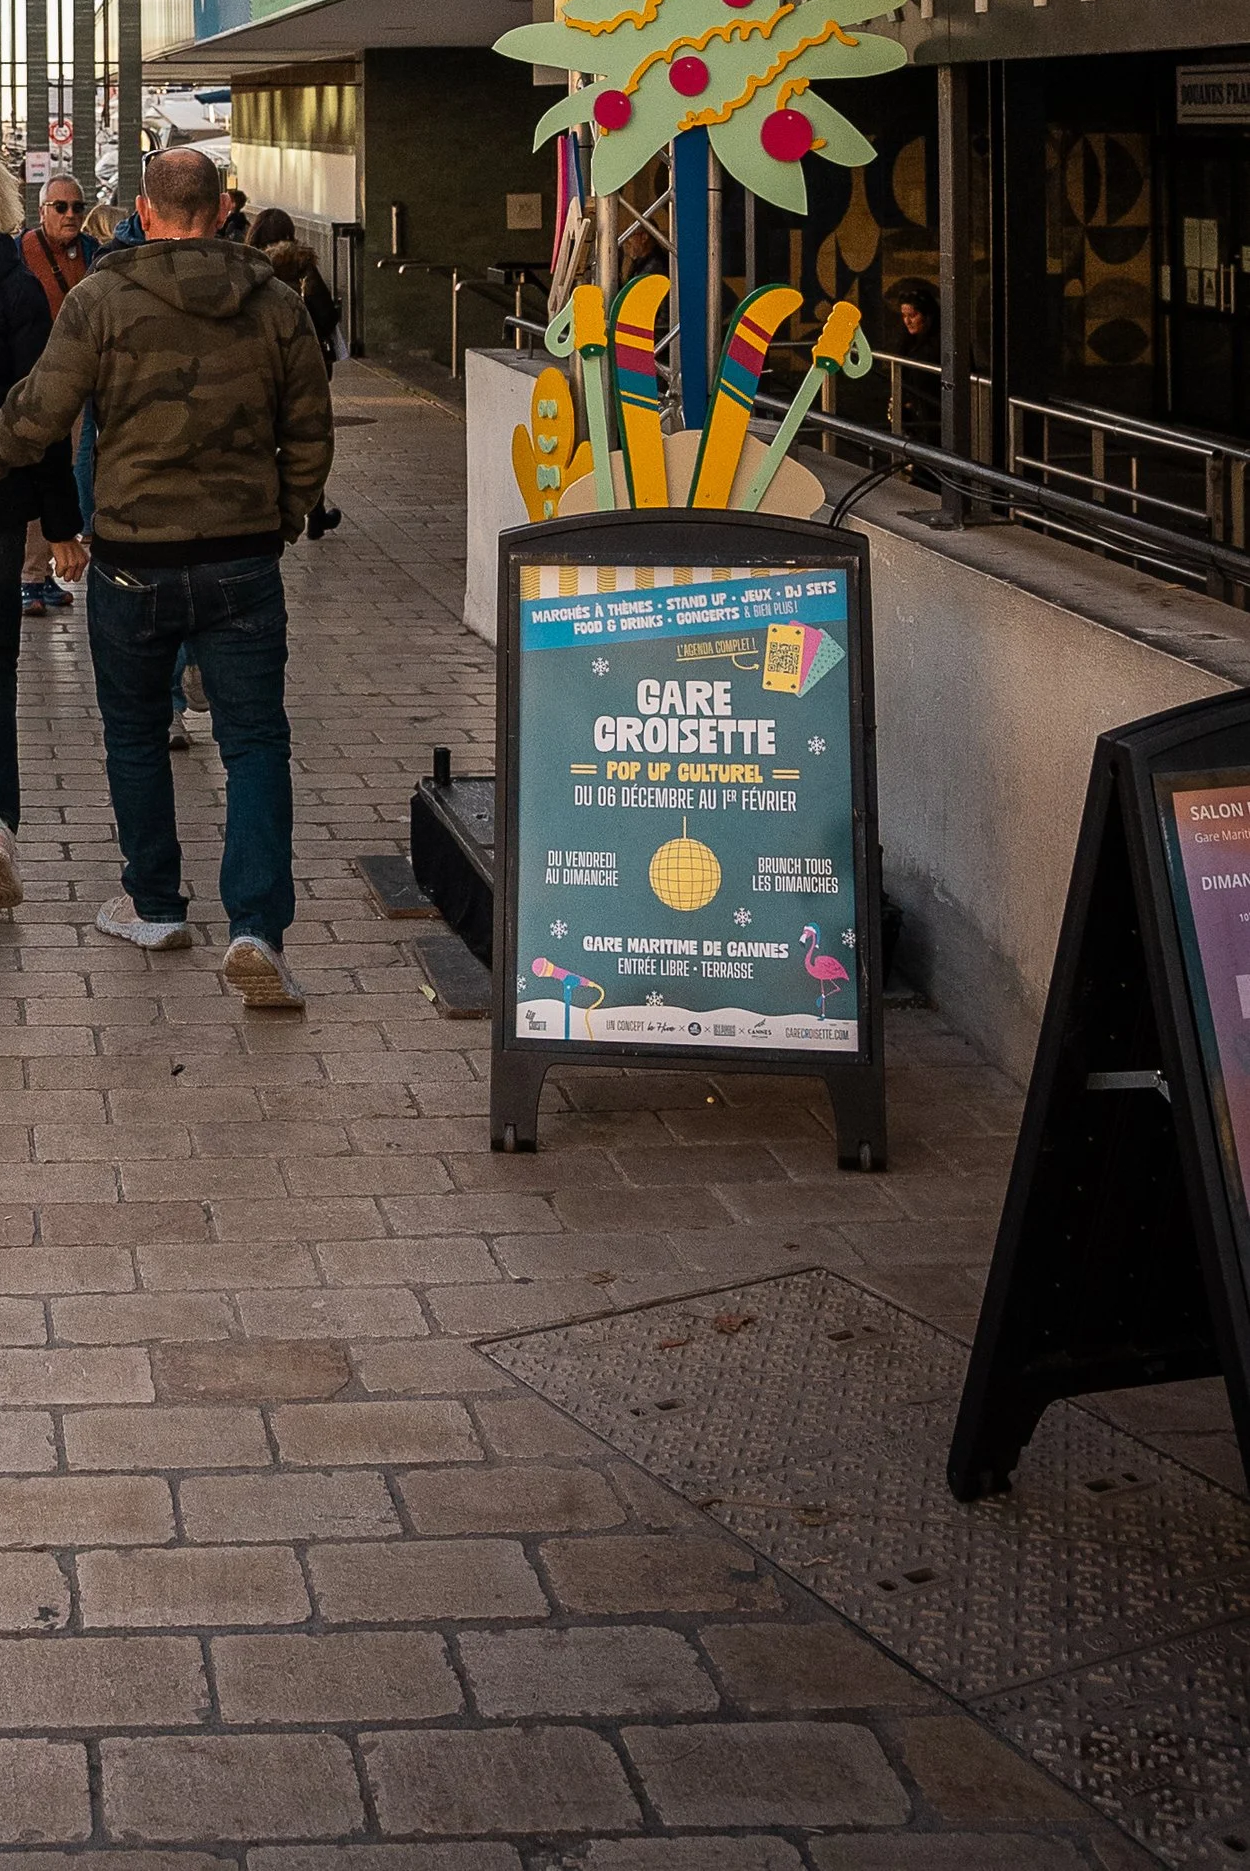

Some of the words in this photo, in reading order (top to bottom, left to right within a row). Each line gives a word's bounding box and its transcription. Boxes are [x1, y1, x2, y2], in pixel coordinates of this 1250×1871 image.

[532, 604, 591, 624] MARCHÉS
[595, 604, 604, 618] À
[607, 599, 653, 617] THÈMES
[666, 594, 708, 611] STAND
[711, 592, 727, 606] UP
[741, 589, 772, 604] JEUX
[785, 585, 802, 599] DJ
[806, 580, 837, 597] SETS
[574, 620, 602, 635] FOOD
[607, 618, 616, 632] &
[621, 613, 664, 630] DRINKS
[676, 607, 740, 625] CONCERTS
[744, 606, 751, 618] &
[753, 604, 772, 617] BIEN
[676, 640, 713, 657] L'AGENDA
[637, 678, 732, 716] GARE
[593, 716, 776, 755] CROISETTE
[606, 761, 641, 780] POP
[648, 762, 671, 781] UP
[678, 763, 764, 784] CULTUREL
[574, 785, 593, 806] DU
[598, 786, 616, 807] 06
[621, 784, 695, 809] DÉCEMBRE
[698, 789, 717, 810] AU
[742, 787, 797, 812] FÉVRIER
[1190, 802, 1244, 821] SALON
[1194, 831, 1220, 844] Gare
[547, 850, 562, 867] DU
[565, 851, 616, 868] VENDREDI
[758, 857, 801, 875] BRUNCH
[804, 858, 832, 876] TOUS
[545, 869, 560, 885] AU
[563, 868, 619, 887] DIMANCHE
[752, 875, 771, 892] LES
[774, 876, 839, 894] DIMANCHES
[582, 935, 623, 952] GARE
[627, 938, 698, 955] MARITIME
[702, 941, 723, 957] DE
[726, 941, 789, 959] CANNES
[618, 957, 657, 976] ENTRÉE
[660, 960, 690, 977] LIBRE
[701, 961, 754, 980] TERRASSE
[617, 1021, 645, 1032] CONCEPT
[747, 1028, 772, 1036] CANNES
[786, 1027, 850, 1041] GARECROISETTE.COM
